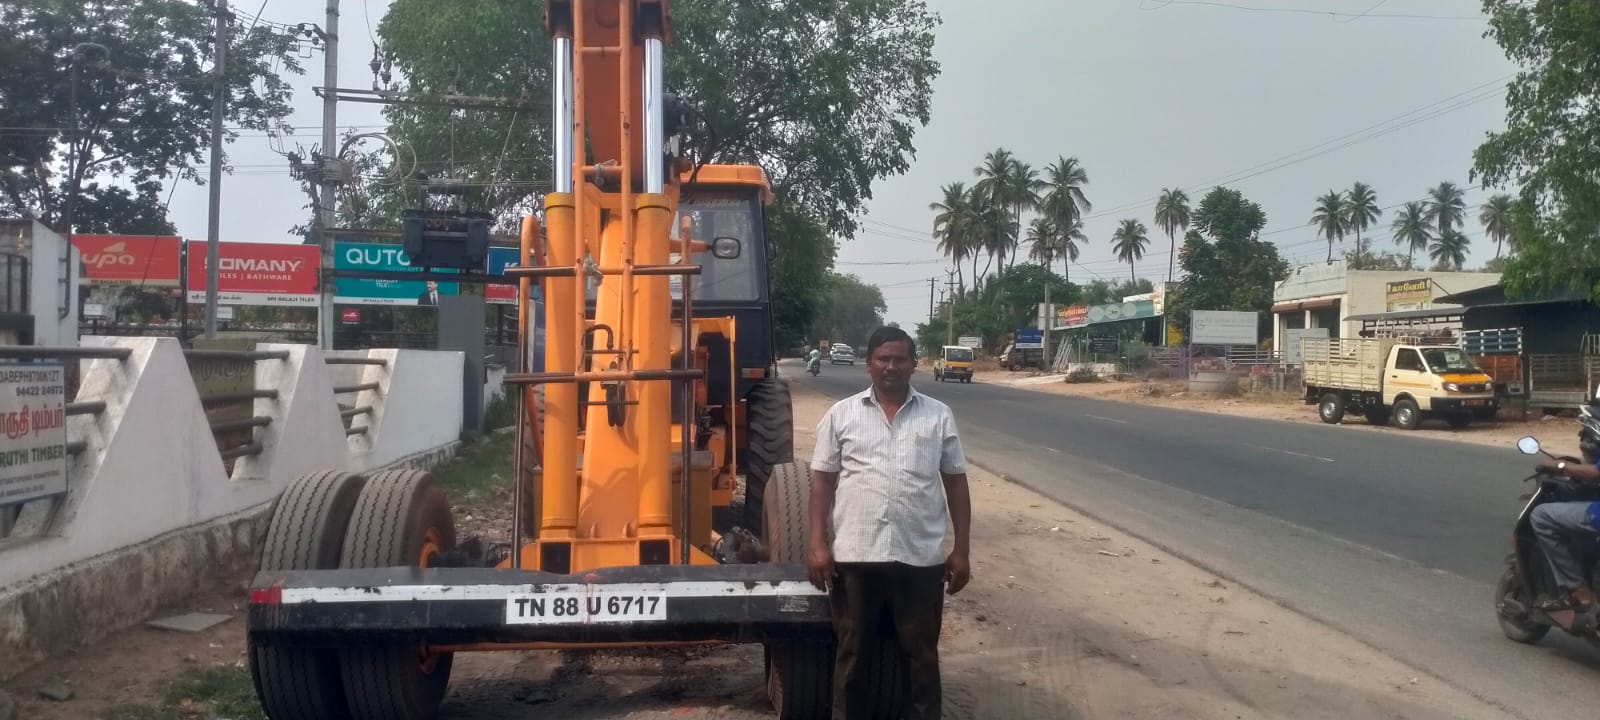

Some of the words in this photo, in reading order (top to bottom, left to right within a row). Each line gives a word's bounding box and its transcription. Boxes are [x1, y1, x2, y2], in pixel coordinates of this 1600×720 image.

[205, 257, 302, 272] OMANY
[247, 273, 292, 281] BATHWARE
[31, 444, 64, 462] TIMBER
[515, 598, 545, 617] TN
[552, 597, 579, 616] 88
[586, 596, 602, 616] U
[607, 596, 661, 615] 6717
